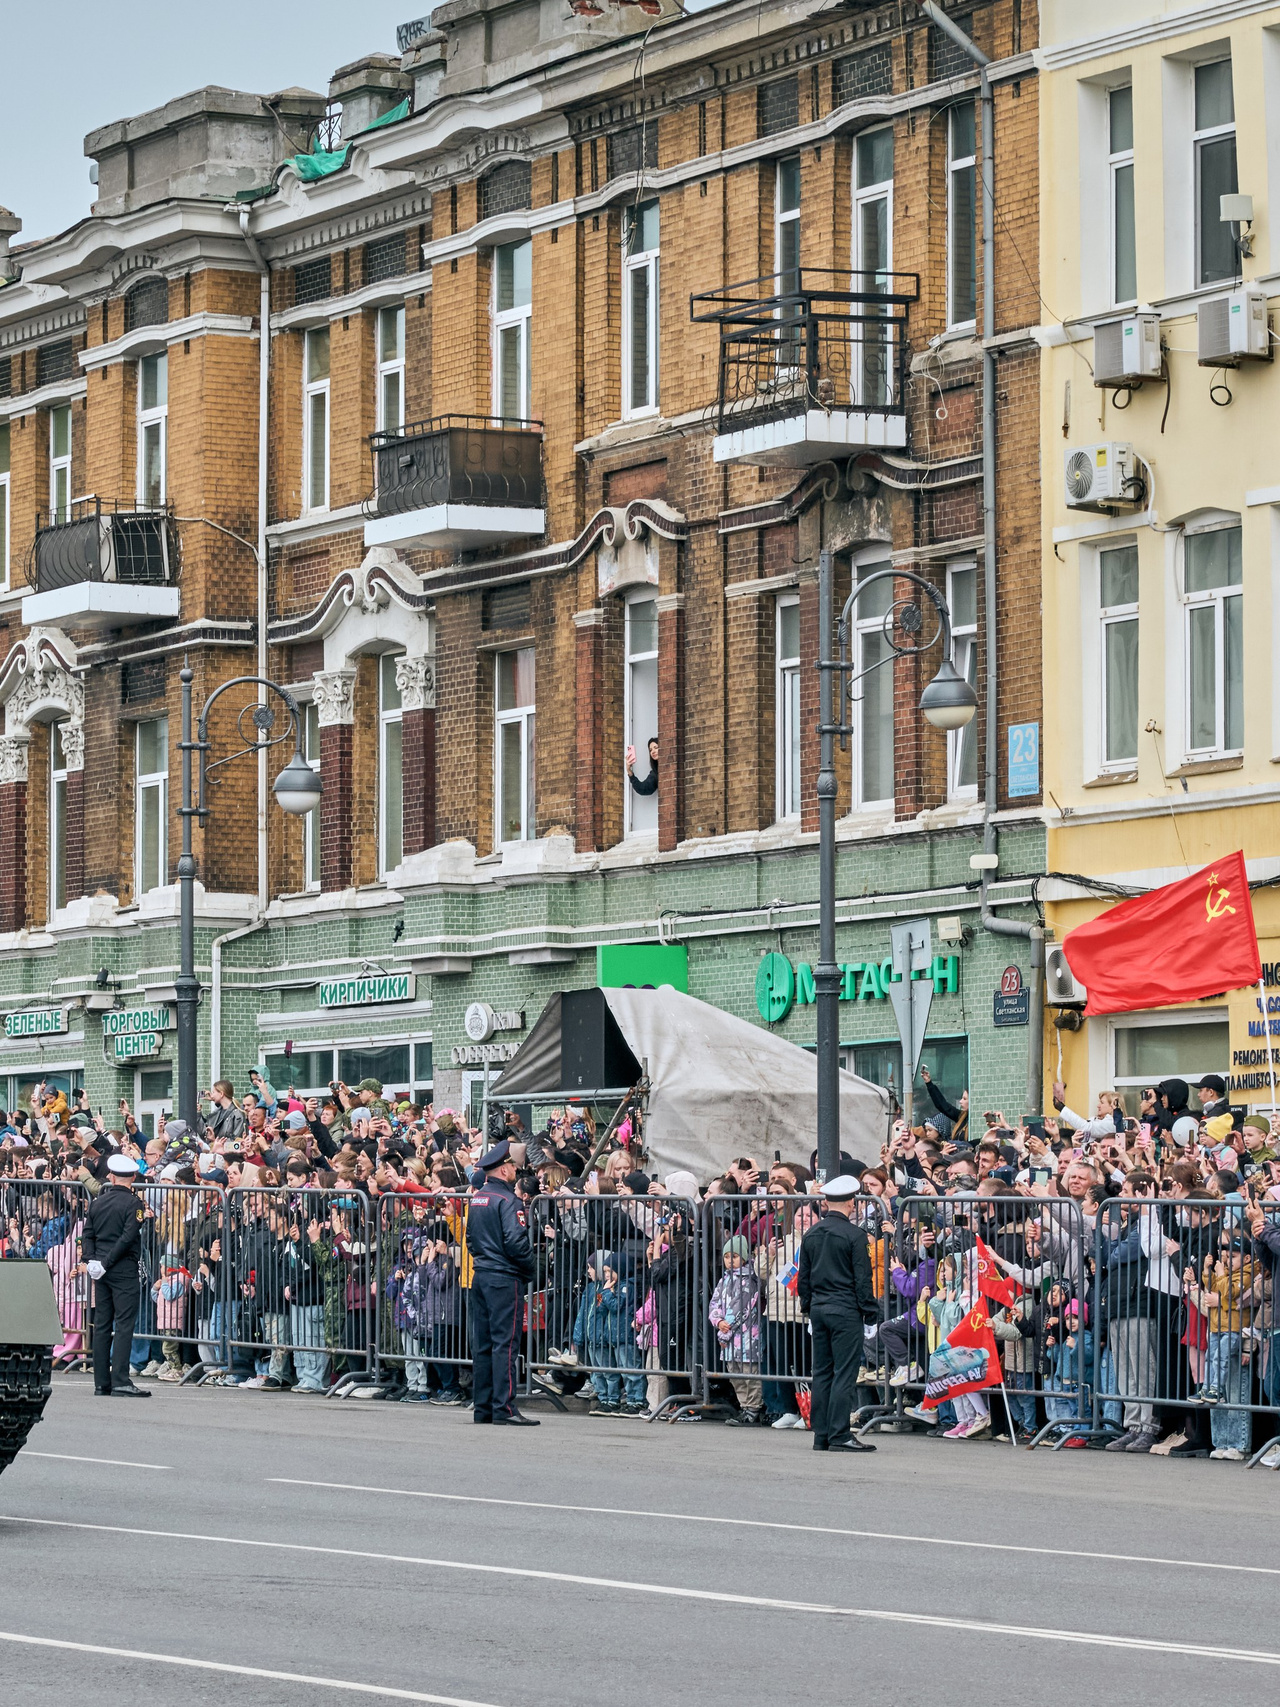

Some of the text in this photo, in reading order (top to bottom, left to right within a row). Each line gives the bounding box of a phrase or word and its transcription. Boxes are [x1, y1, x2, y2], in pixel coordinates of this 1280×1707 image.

[1012, 727, 1036, 764] 23
[321, 975, 408, 1006] КИРПИЧИКИ
[797, 955, 959, 1005] МГАН
[1004, 971, 1018, 992] 23
[5, 1010, 61, 1037] ЗЕЛЕНЫЕ
[102, 1007, 171, 1036] ТОРГОВЫЙ
[115, 1032, 157, 1059] ЦЕНТР
[1233, 1049, 1267, 1066] РЕМОНТ
[1225, 1071, 1277, 1091] ПЛАНШЕТОВ
